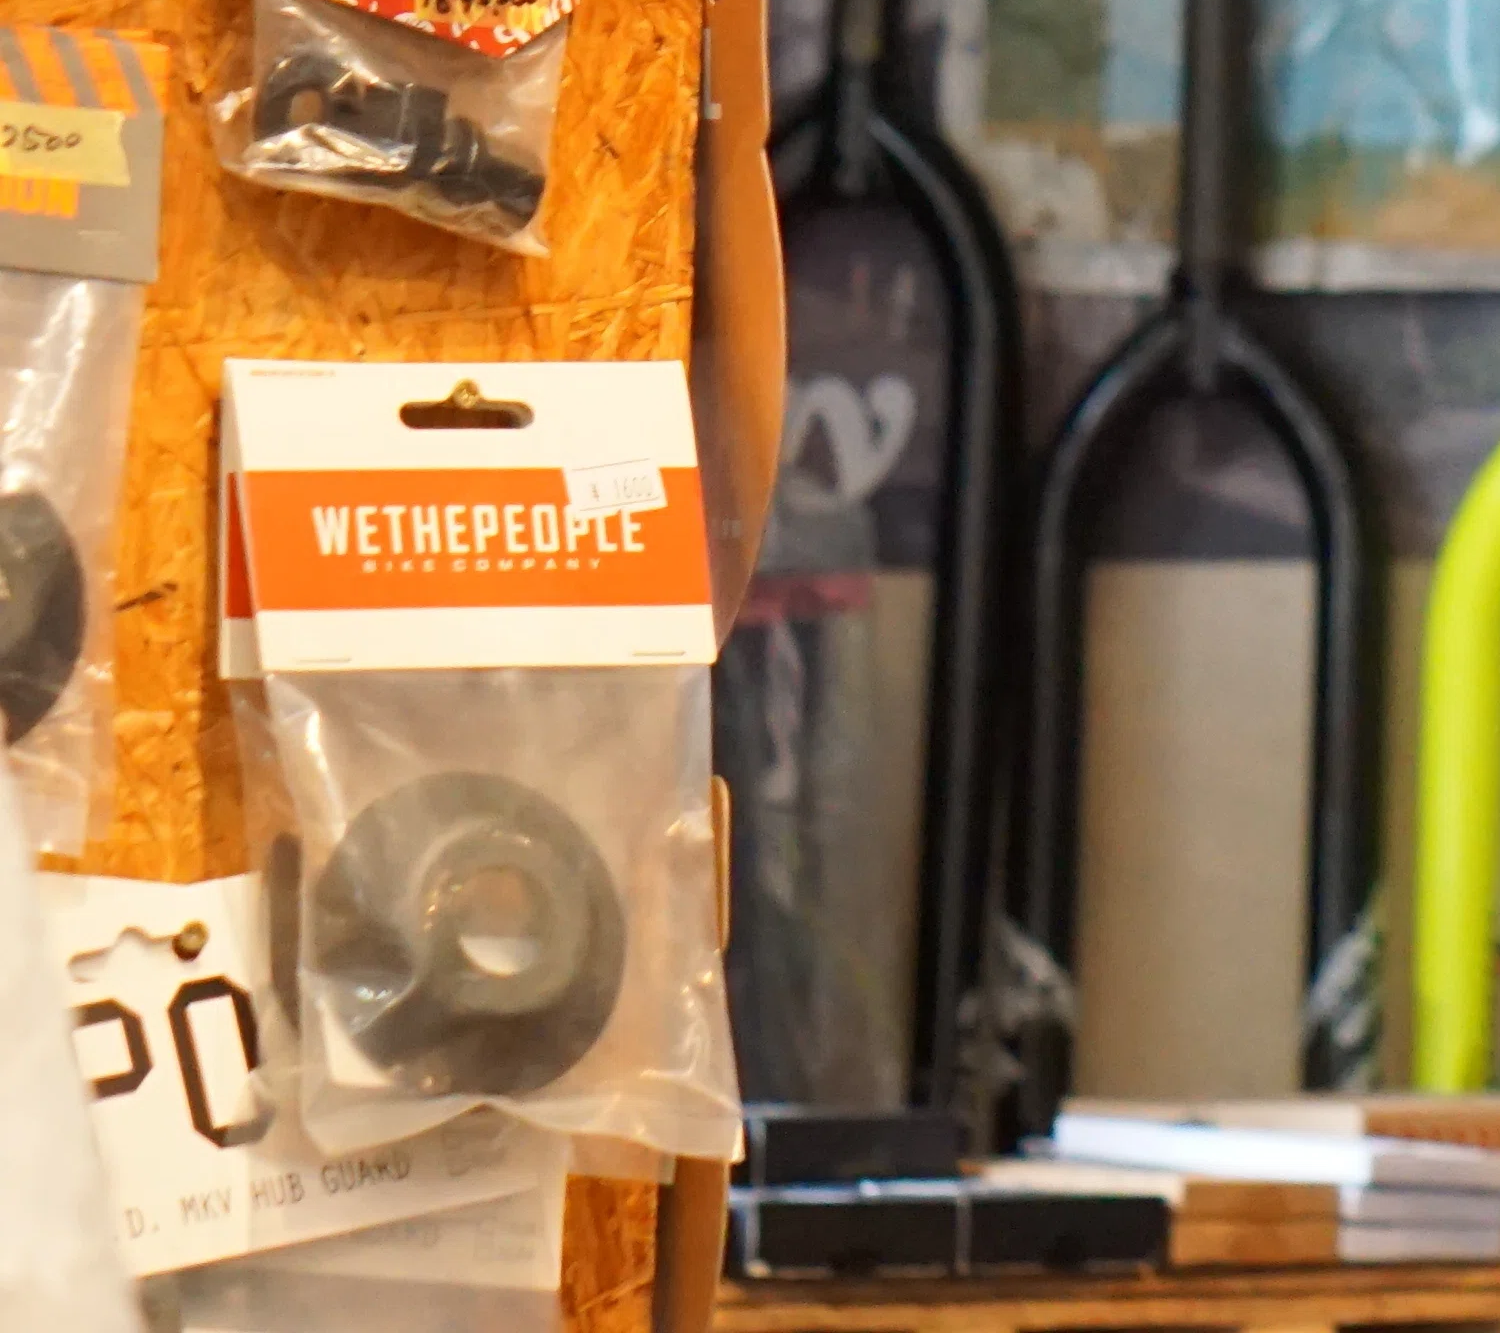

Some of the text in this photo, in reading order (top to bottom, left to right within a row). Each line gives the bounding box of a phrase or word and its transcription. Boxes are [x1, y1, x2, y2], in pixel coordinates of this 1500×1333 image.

[311, 503, 646, 557] WETHEPEOPLE
[362, 557, 602, 573] BIKE COMPANY
[250, 1172, 306, 1212] HUB
[319, 1151, 413, 1196] GUARD
